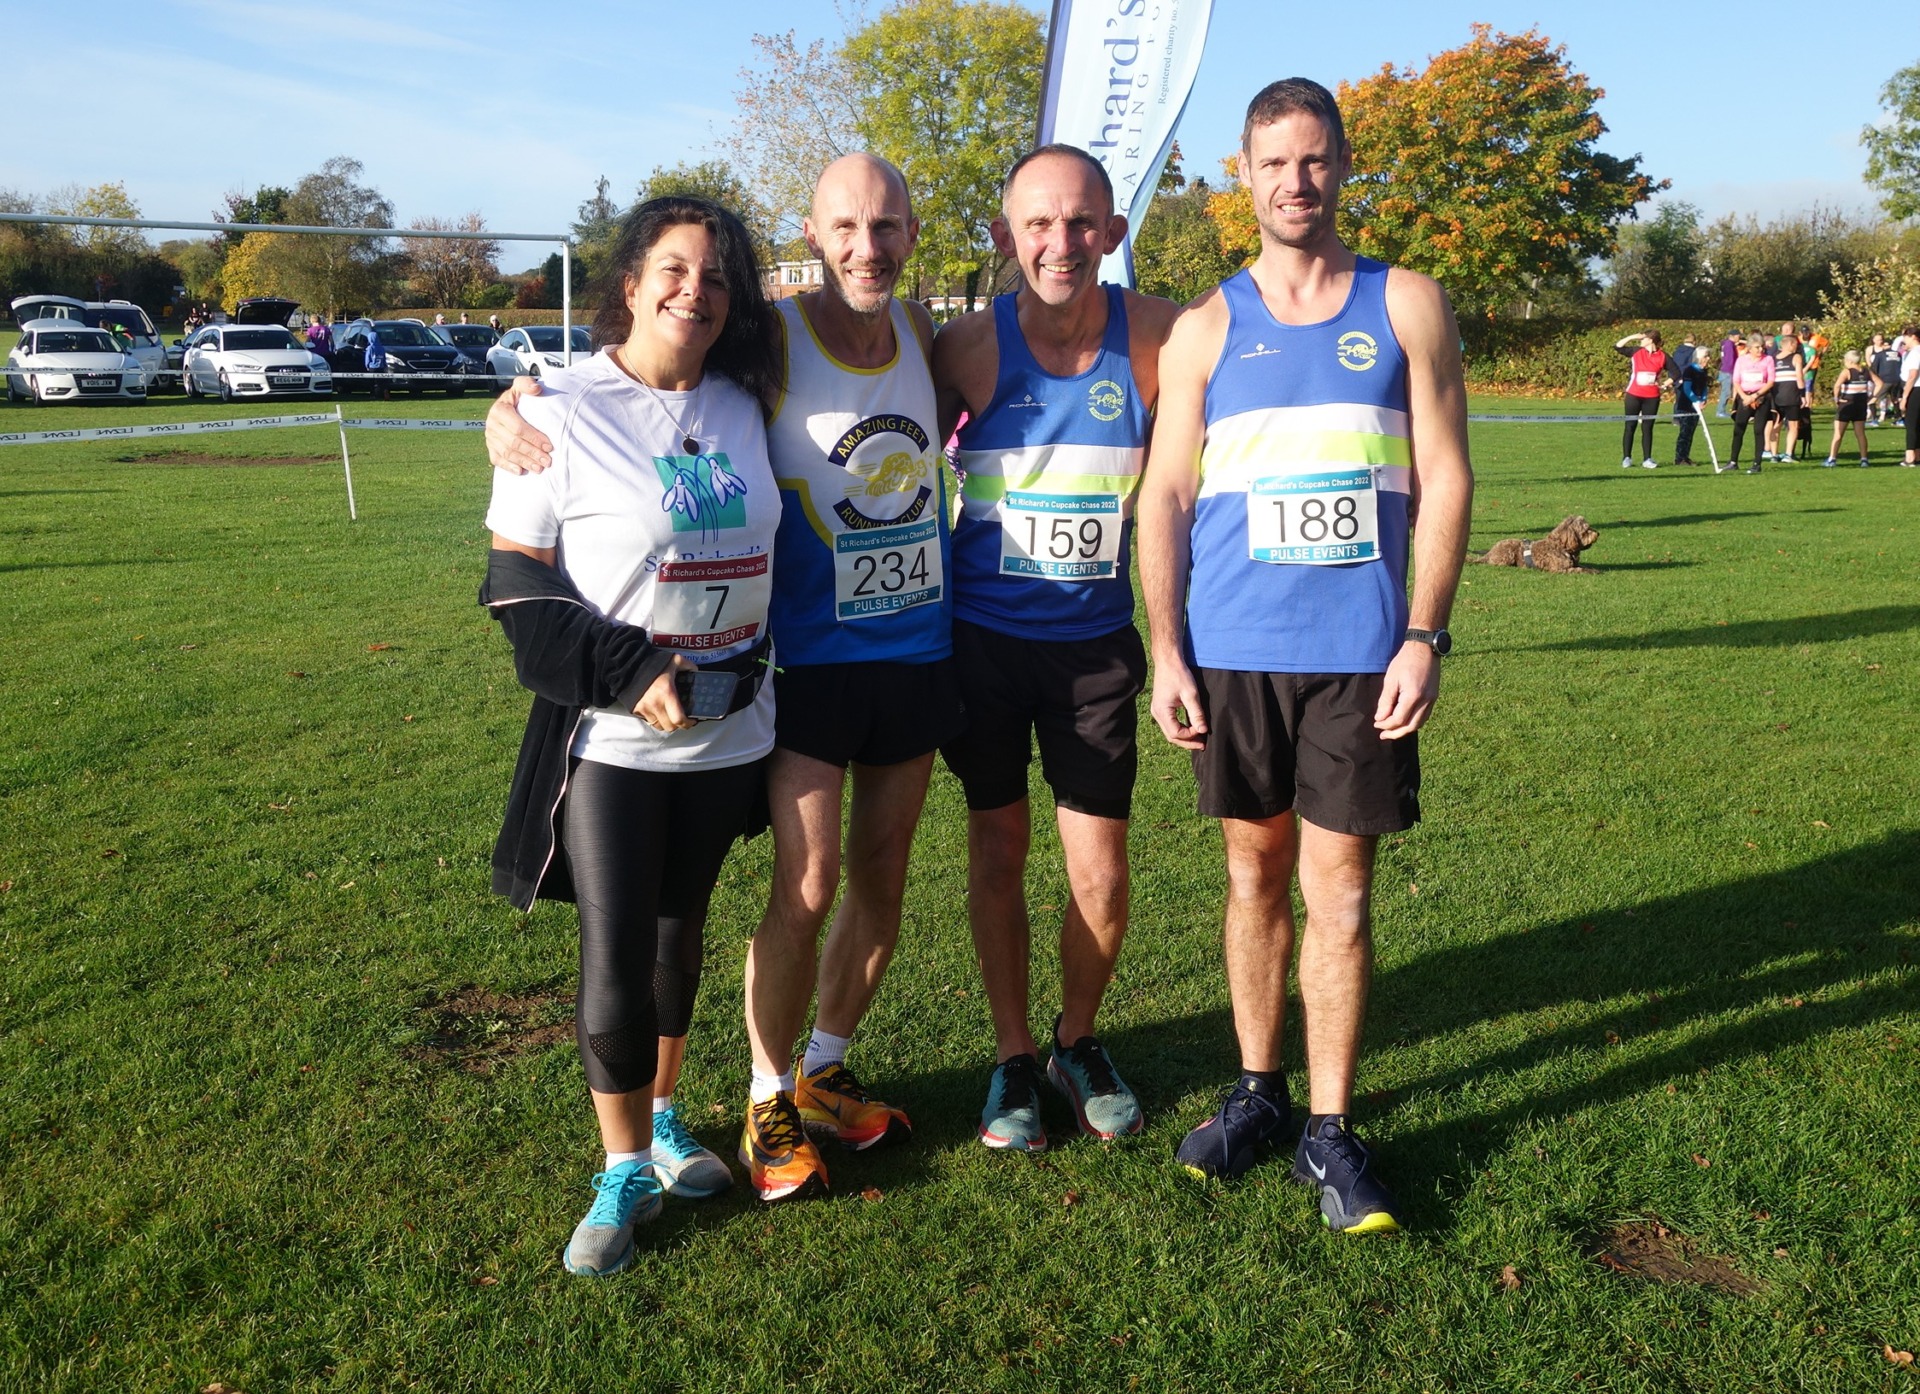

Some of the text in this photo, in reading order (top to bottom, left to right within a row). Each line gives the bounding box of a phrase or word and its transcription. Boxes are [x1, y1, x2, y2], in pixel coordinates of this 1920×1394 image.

[1157, 57, 1172, 105] Registered
[1165, 23, 1178, 56] charity
[1119, 73, 1150, 212] CARING
[837, 417, 925, 458] AMAZING FEET
[1298, 480, 1330, 490] Cupcake
[1331, 478, 1353, 488] Chase
[1354, 476, 1369, 485] 2022
[900, 498, 925, 525] CLUB
[1018, 498, 1050, 508] Richard's
[1050, 500, 1080, 510] Cupcake
[1081, 500, 1100, 509] Chase
[1101, 501, 1116, 509] 2022
[1272, 496, 1359, 543] 188
[840, 525, 936, 548] St Richard's Cupcake Chase 2022
[1024, 516, 1103, 559] 159
[1269, 545, 1359, 560] PULSE EVENTS
[663, 561, 766, 577] St Richard's Cupcake Chase 2022
[853, 546, 930, 597] 234
[1019, 560, 1099, 575] PULSE EVENTS
[705, 585, 730, 630] 7
[853, 590, 929, 613] PULSE EVENTS
[670, 626, 747, 648] PULSE EVENTS
